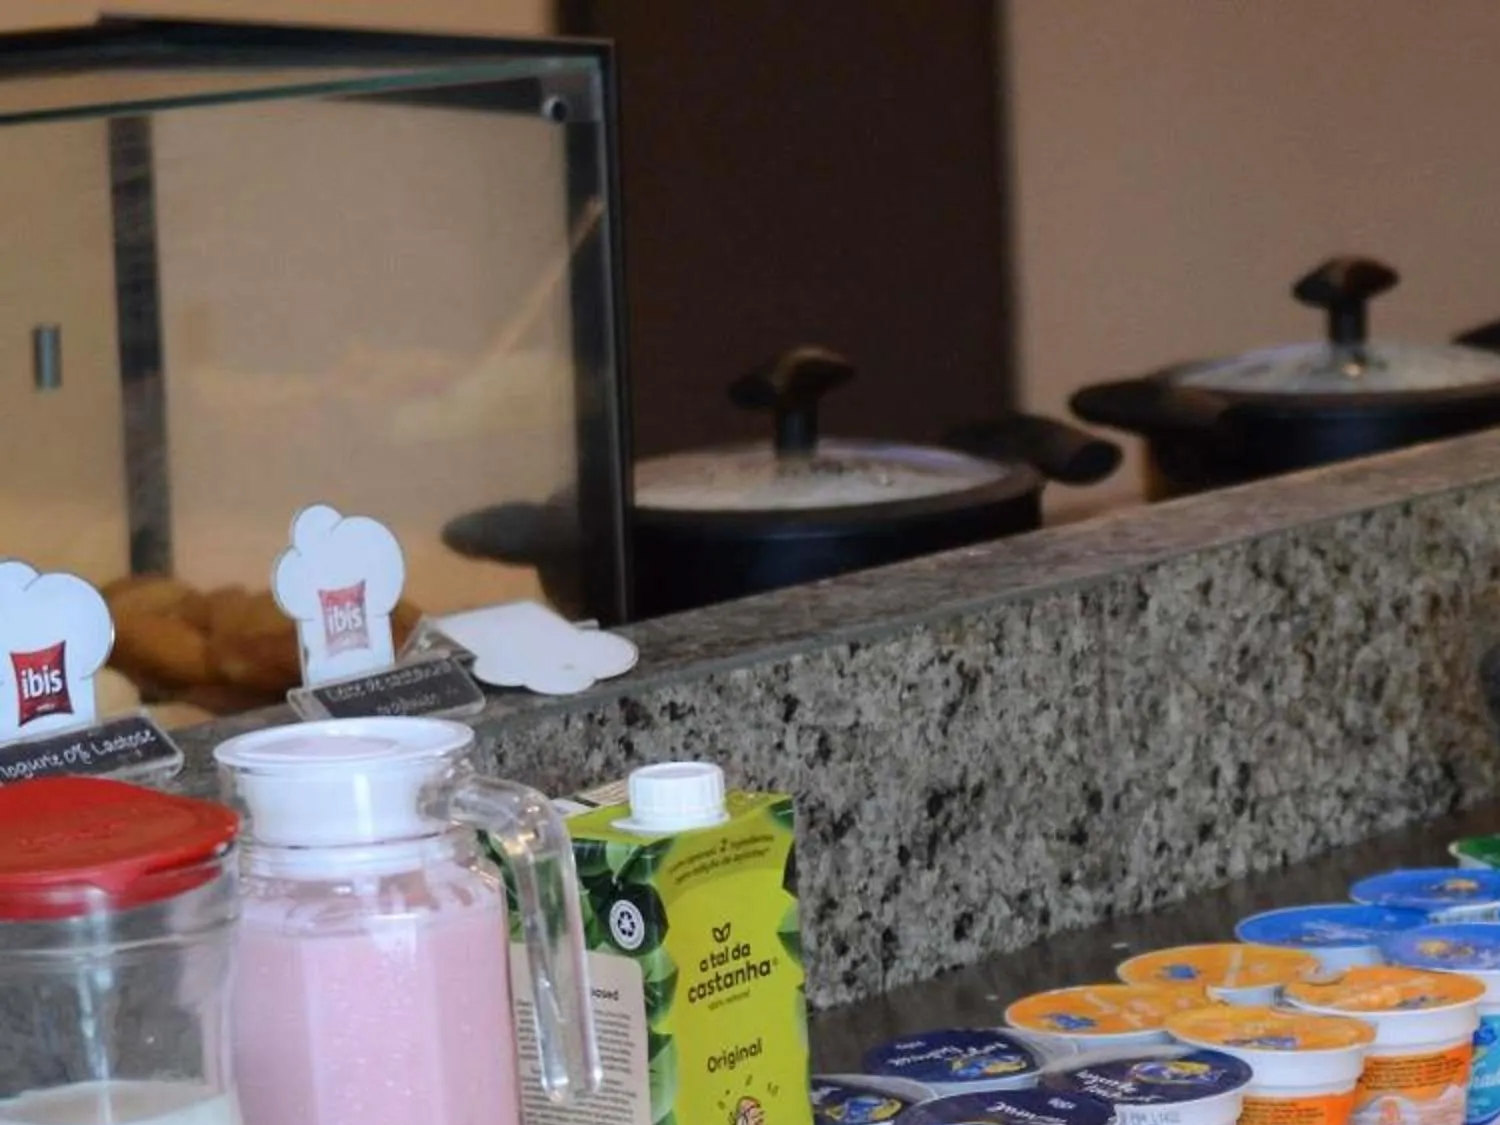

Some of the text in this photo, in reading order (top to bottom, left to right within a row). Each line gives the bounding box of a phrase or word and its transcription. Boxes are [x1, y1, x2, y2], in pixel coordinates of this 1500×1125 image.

[326, 602, 363, 633] ibis
[21, 664, 63, 699] ibis
[710, 945, 730, 969] tal
[731, 943, 751, 960] da
[688, 958, 772, 1003] castanha
[707, 1038, 763, 1074] Original
